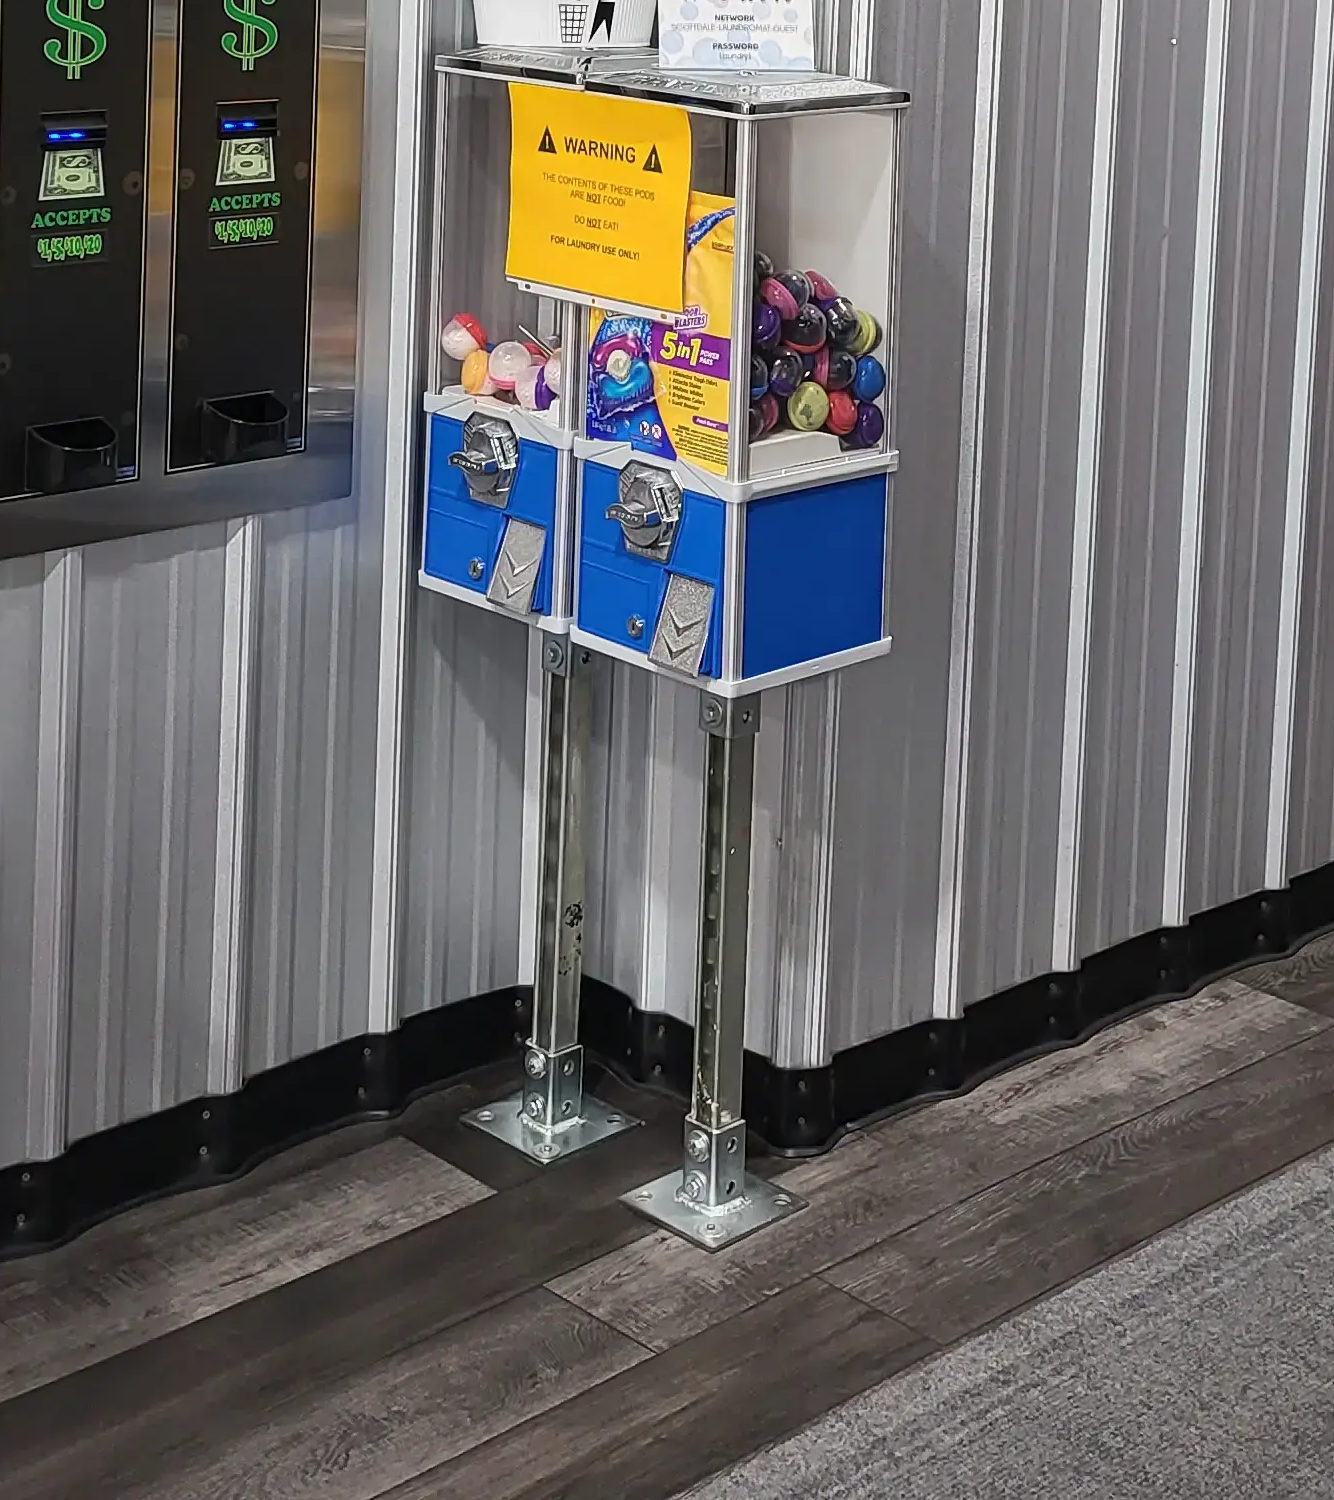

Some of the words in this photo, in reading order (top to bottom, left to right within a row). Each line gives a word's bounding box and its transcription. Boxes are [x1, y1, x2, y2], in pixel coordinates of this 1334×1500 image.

[714, 14, 755, 22] NETWORK
[712, 42, 759, 50] PASSWORD
[563, 135, 636, 164] WARNING
[542, 172, 556, 183] THE
[557, 175, 597, 190] CONTENTS
[597, 181, 609, 192] OF
[609, 184, 634, 197] THESE
[634, 189, 655, 202] PODS
[208, 191, 281, 212] ACCEPTS
[569, 190, 585, 200] ARE
[586, 192, 602, 204] NOT
[603, 195, 626, 207] FOOD!
[30, 207, 112, 229] ACCEPTS
[574, 214, 585, 225] DO
[586, 217, 602, 229] NOT
[602, 220, 619, 231] EAT!
[550, 234, 565, 246] FOR
[566, 238, 601, 252] LAUNDRY
[601, 245, 617, 256] USE
[618, 248, 640, 261] ONLY!
